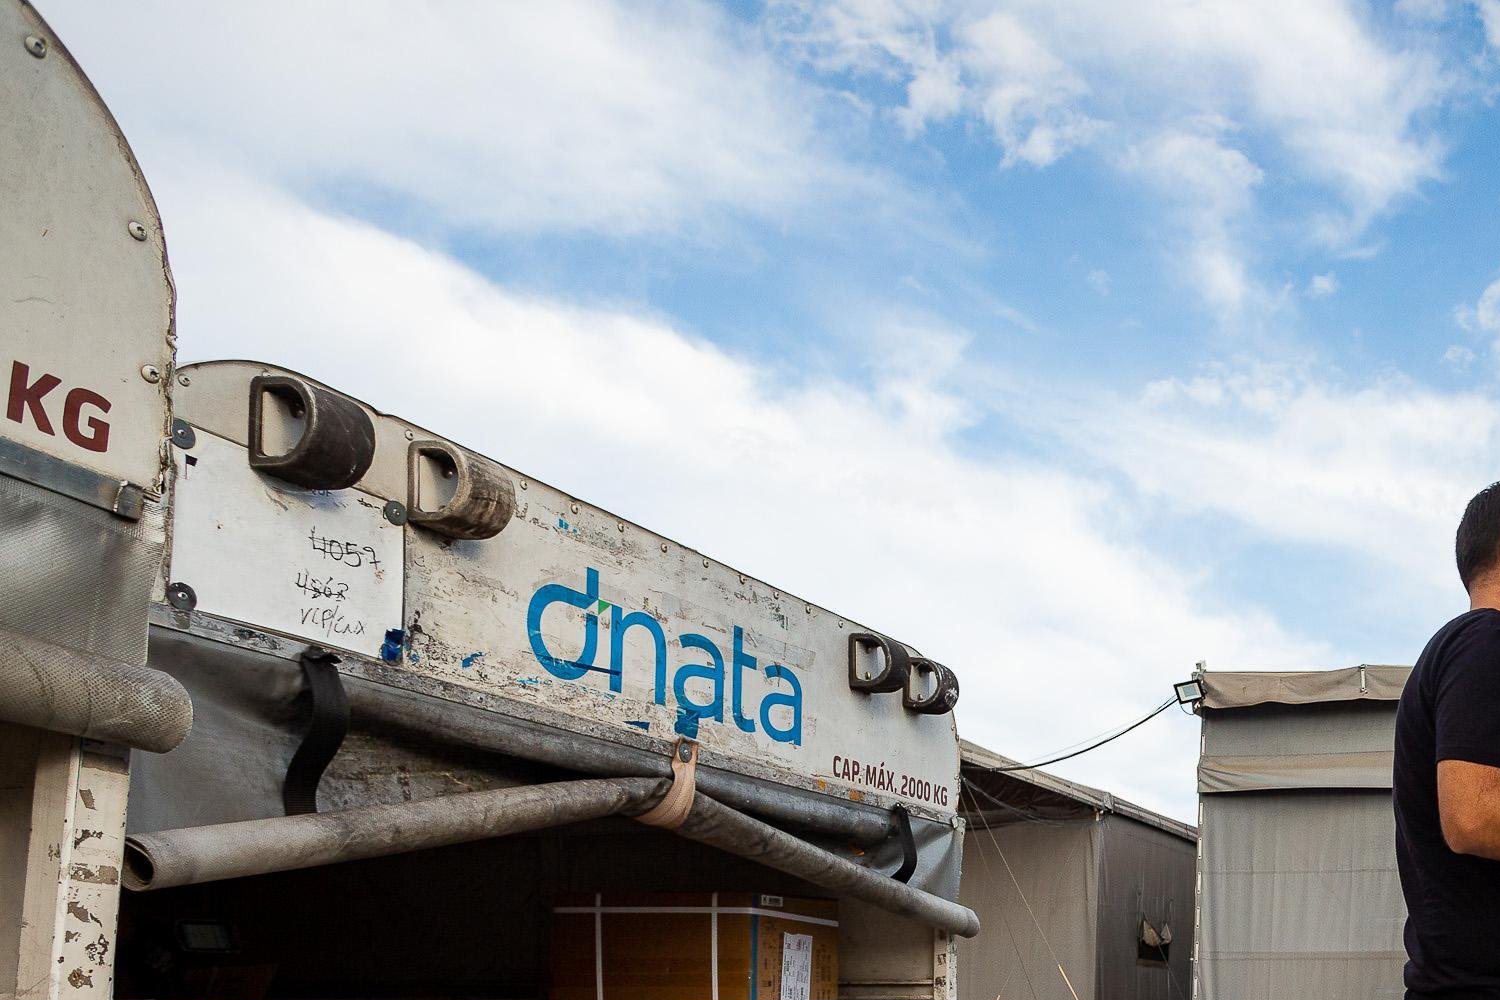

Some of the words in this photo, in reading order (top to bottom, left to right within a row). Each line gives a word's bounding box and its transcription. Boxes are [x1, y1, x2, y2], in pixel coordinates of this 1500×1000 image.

[6, 360, 112, 453] KG
[526, 566, 803, 747] dnata
[832, 754, 862, 784] CAP.
[900, 774, 931, 802] 2000
[933, 784, 948, 807] KG
